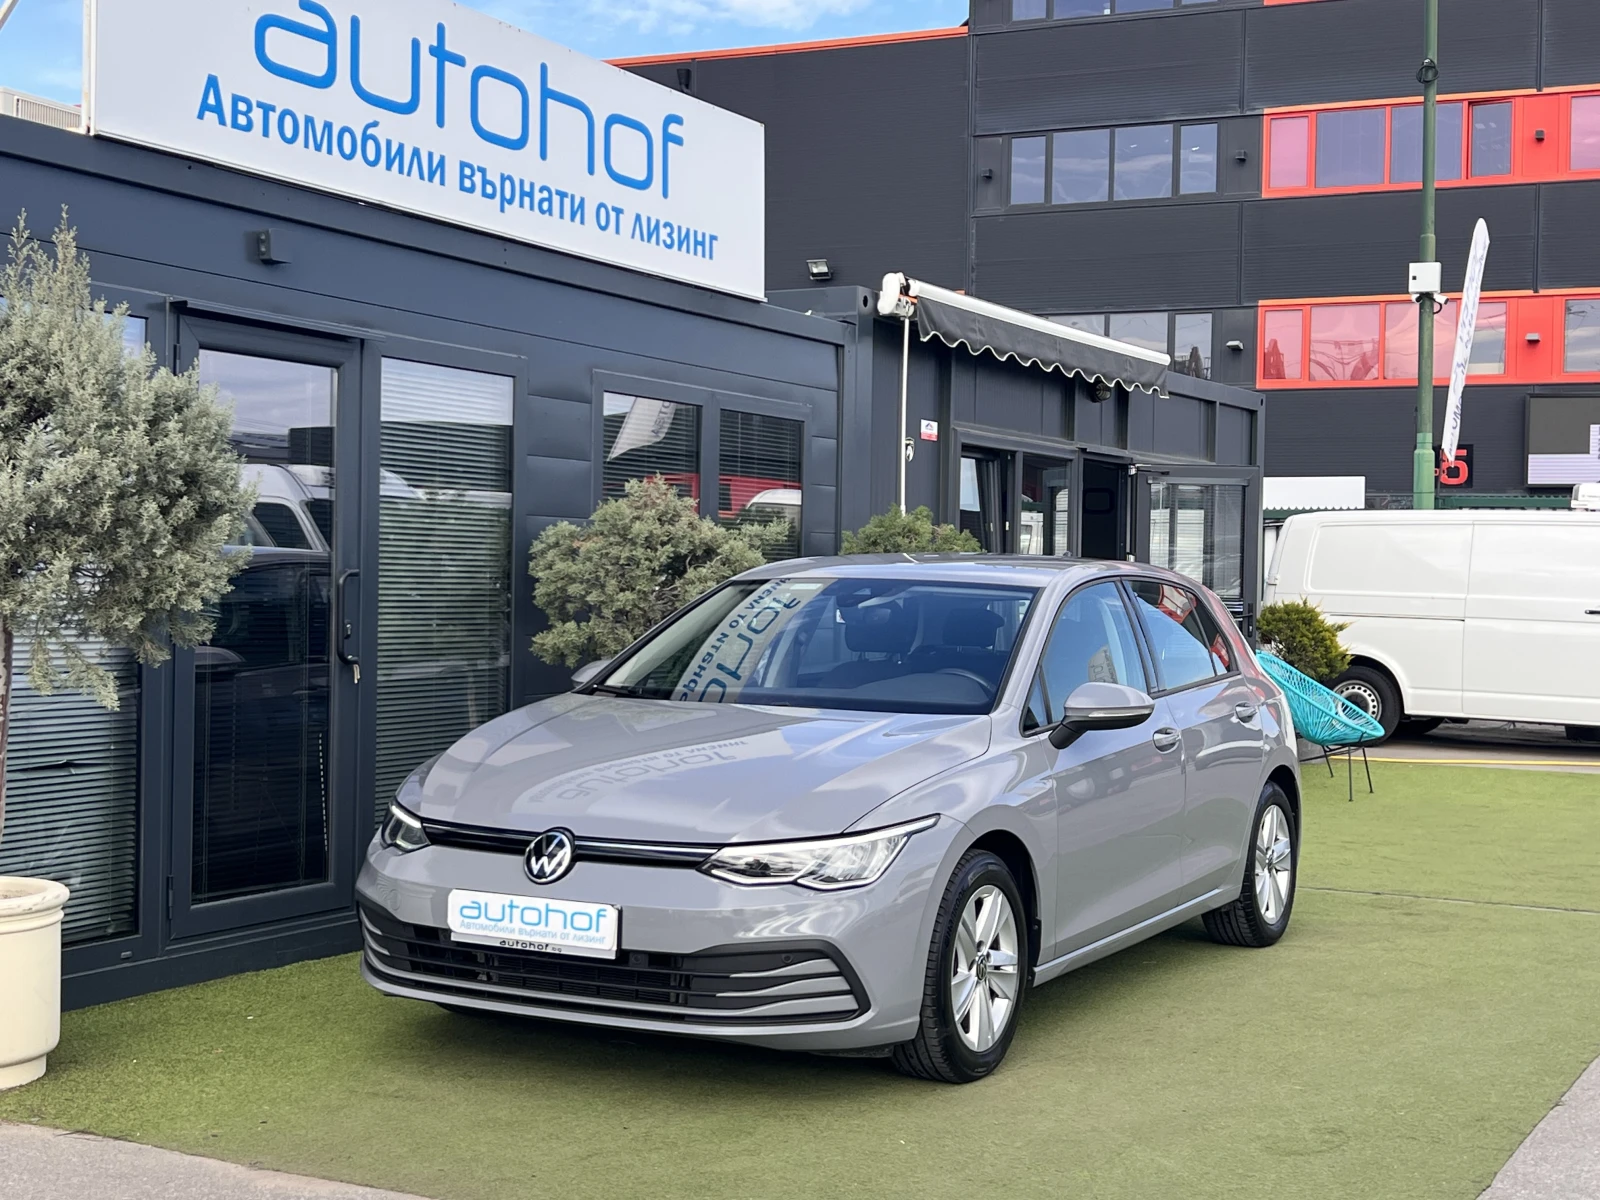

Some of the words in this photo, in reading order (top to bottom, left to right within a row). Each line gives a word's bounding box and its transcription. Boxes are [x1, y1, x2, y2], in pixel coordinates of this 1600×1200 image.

[255, 0, 684, 199] autohof
[197, 74, 446, 187] Автомобили
[459, 160, 586, 215] върнати
[595, 201, 624, 235] от
[631, 213, 718, 261] лизинг
[459, 899, 608, 932] autohof
[459, 919, 515, 935] Автомобили
[518, 928, 558, 940] върнати
[573, 935, 606, 944] лизинг
[500, 939, 549, 951] autohof
